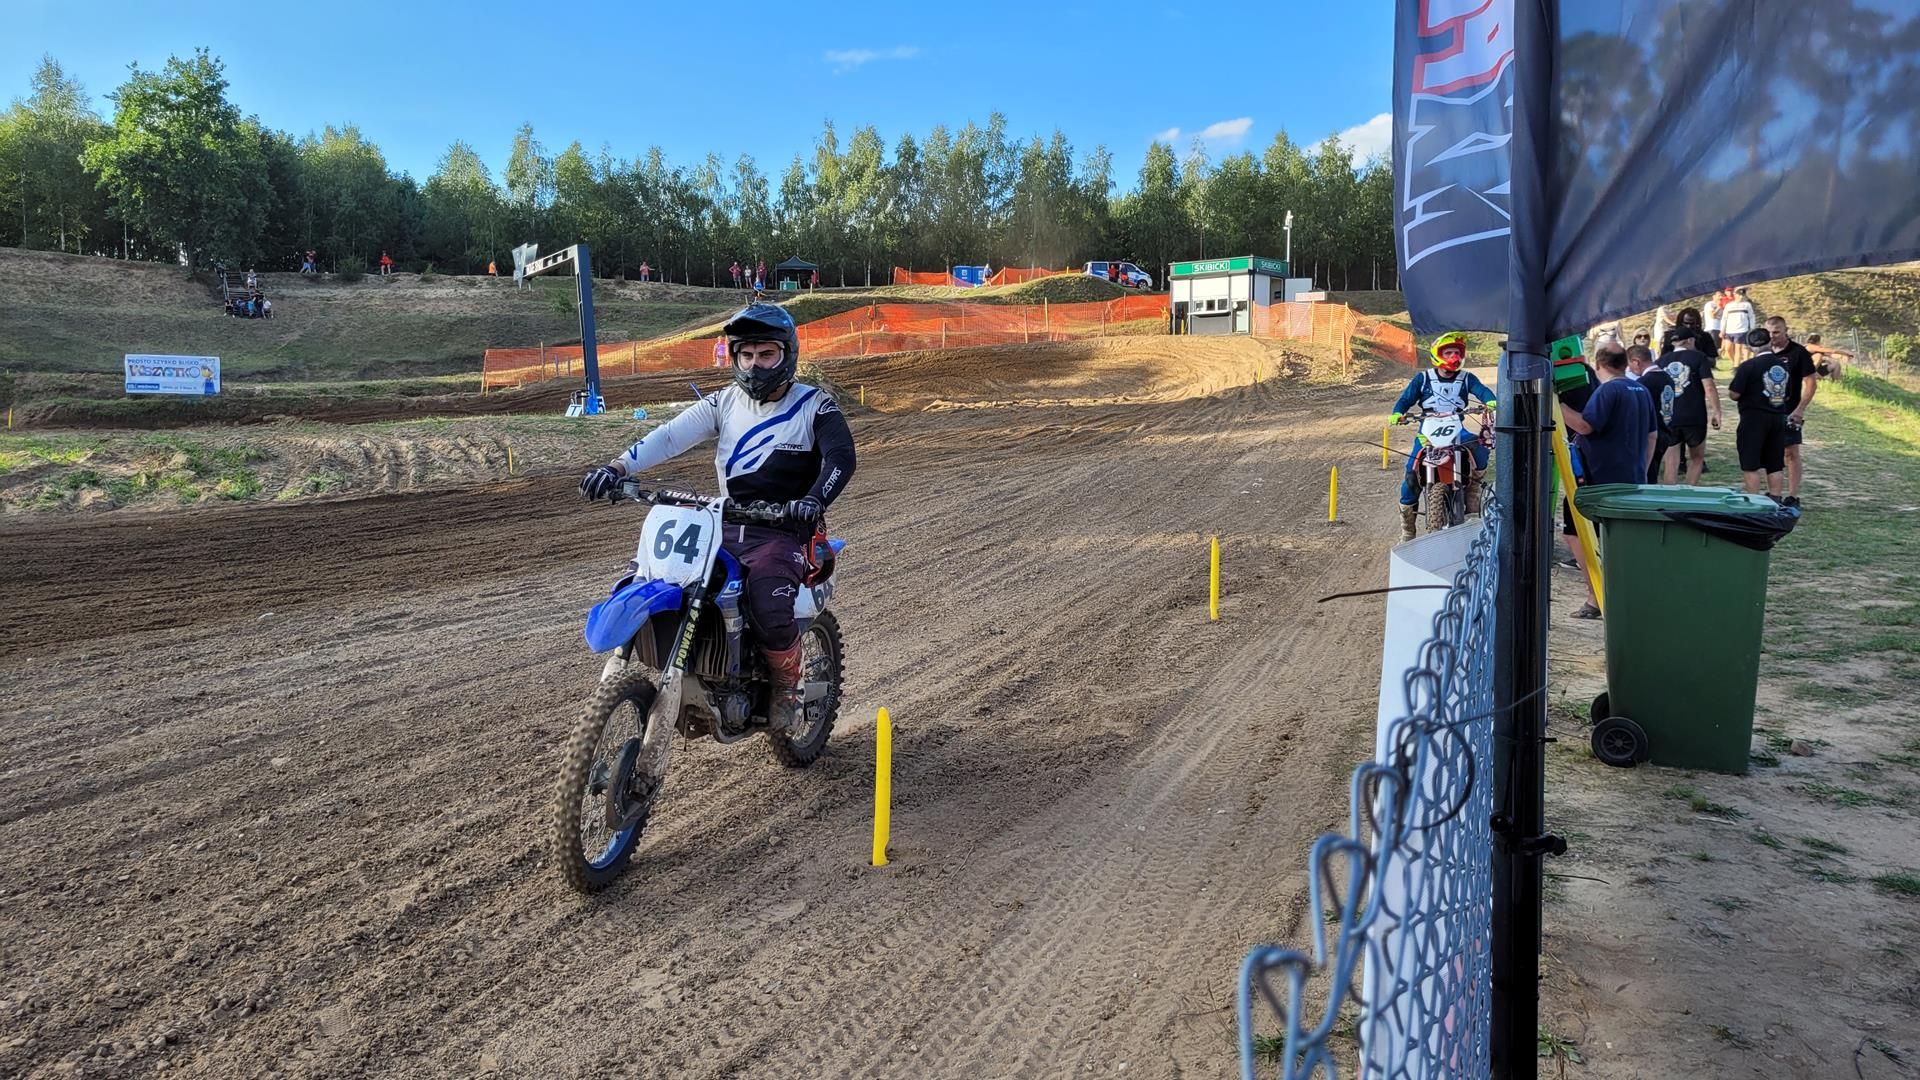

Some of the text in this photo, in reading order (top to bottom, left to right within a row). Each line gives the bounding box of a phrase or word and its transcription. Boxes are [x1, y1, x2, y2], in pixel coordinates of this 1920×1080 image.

[1430, 425, 1456, 438] 46
[653, 519, 702, 565] 64
[675, 622, 696, 668] POWER
